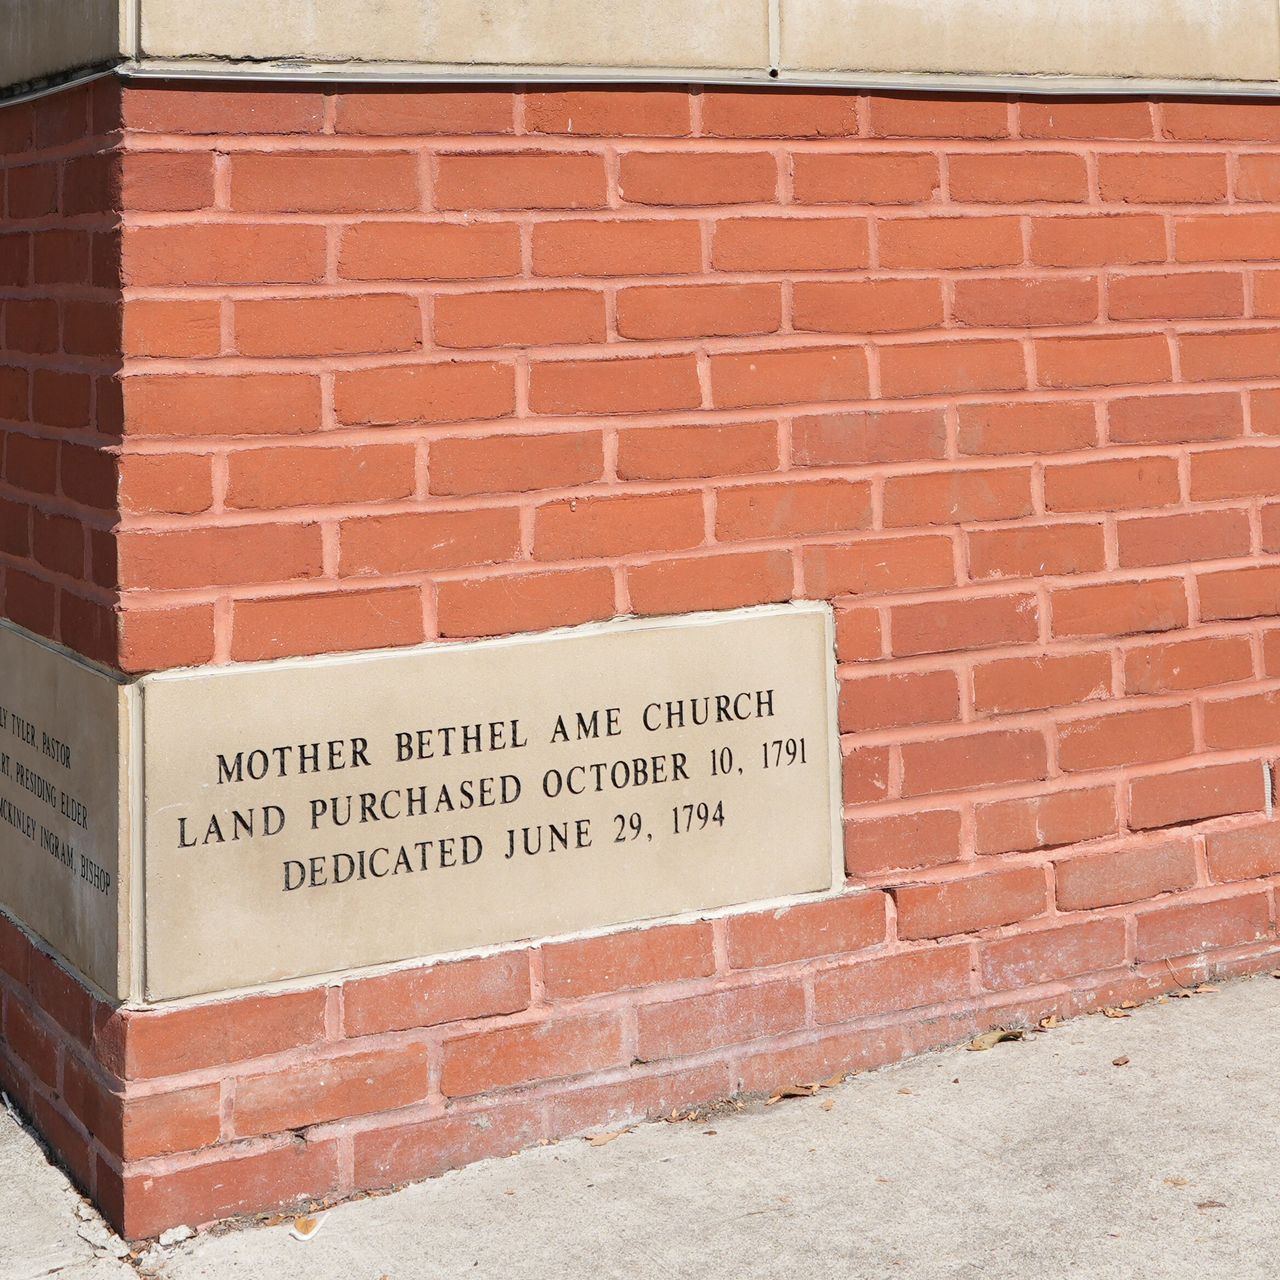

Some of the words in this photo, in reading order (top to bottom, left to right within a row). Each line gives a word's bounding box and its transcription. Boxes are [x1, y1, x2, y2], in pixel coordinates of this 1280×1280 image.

[11, 713, 39, 750] TYLER,
[42, 732, 71, 769] PASTOR
[217, 738, 371, 784] MOTHER
[395, 720, 527, 761] BETHEL
[551, 708, 621, 743] AME
[643, 690, 774, 731] CHURCH
[16, 762, 57, 808] PRESIDING
[60, 791, 88, 830] ELDER
[178, 806, 285, 848] LAND
[310, 775, 520, 829] PURCHASED
[543, 753, 689, 797] OCTOBER
[711, 747, 745, 776] 10,
[763, 738, 806, 768] 1791
[40, 825, 76, 874] INGRAM,
[80, 854, 111, 896] BISHOP
[283, 835, 482, 891] DEDICATED
[505, 820, 592, 858] JUNE
[614, 813, 653, 843] 29,
[673, 801, 724, 833] 1794
